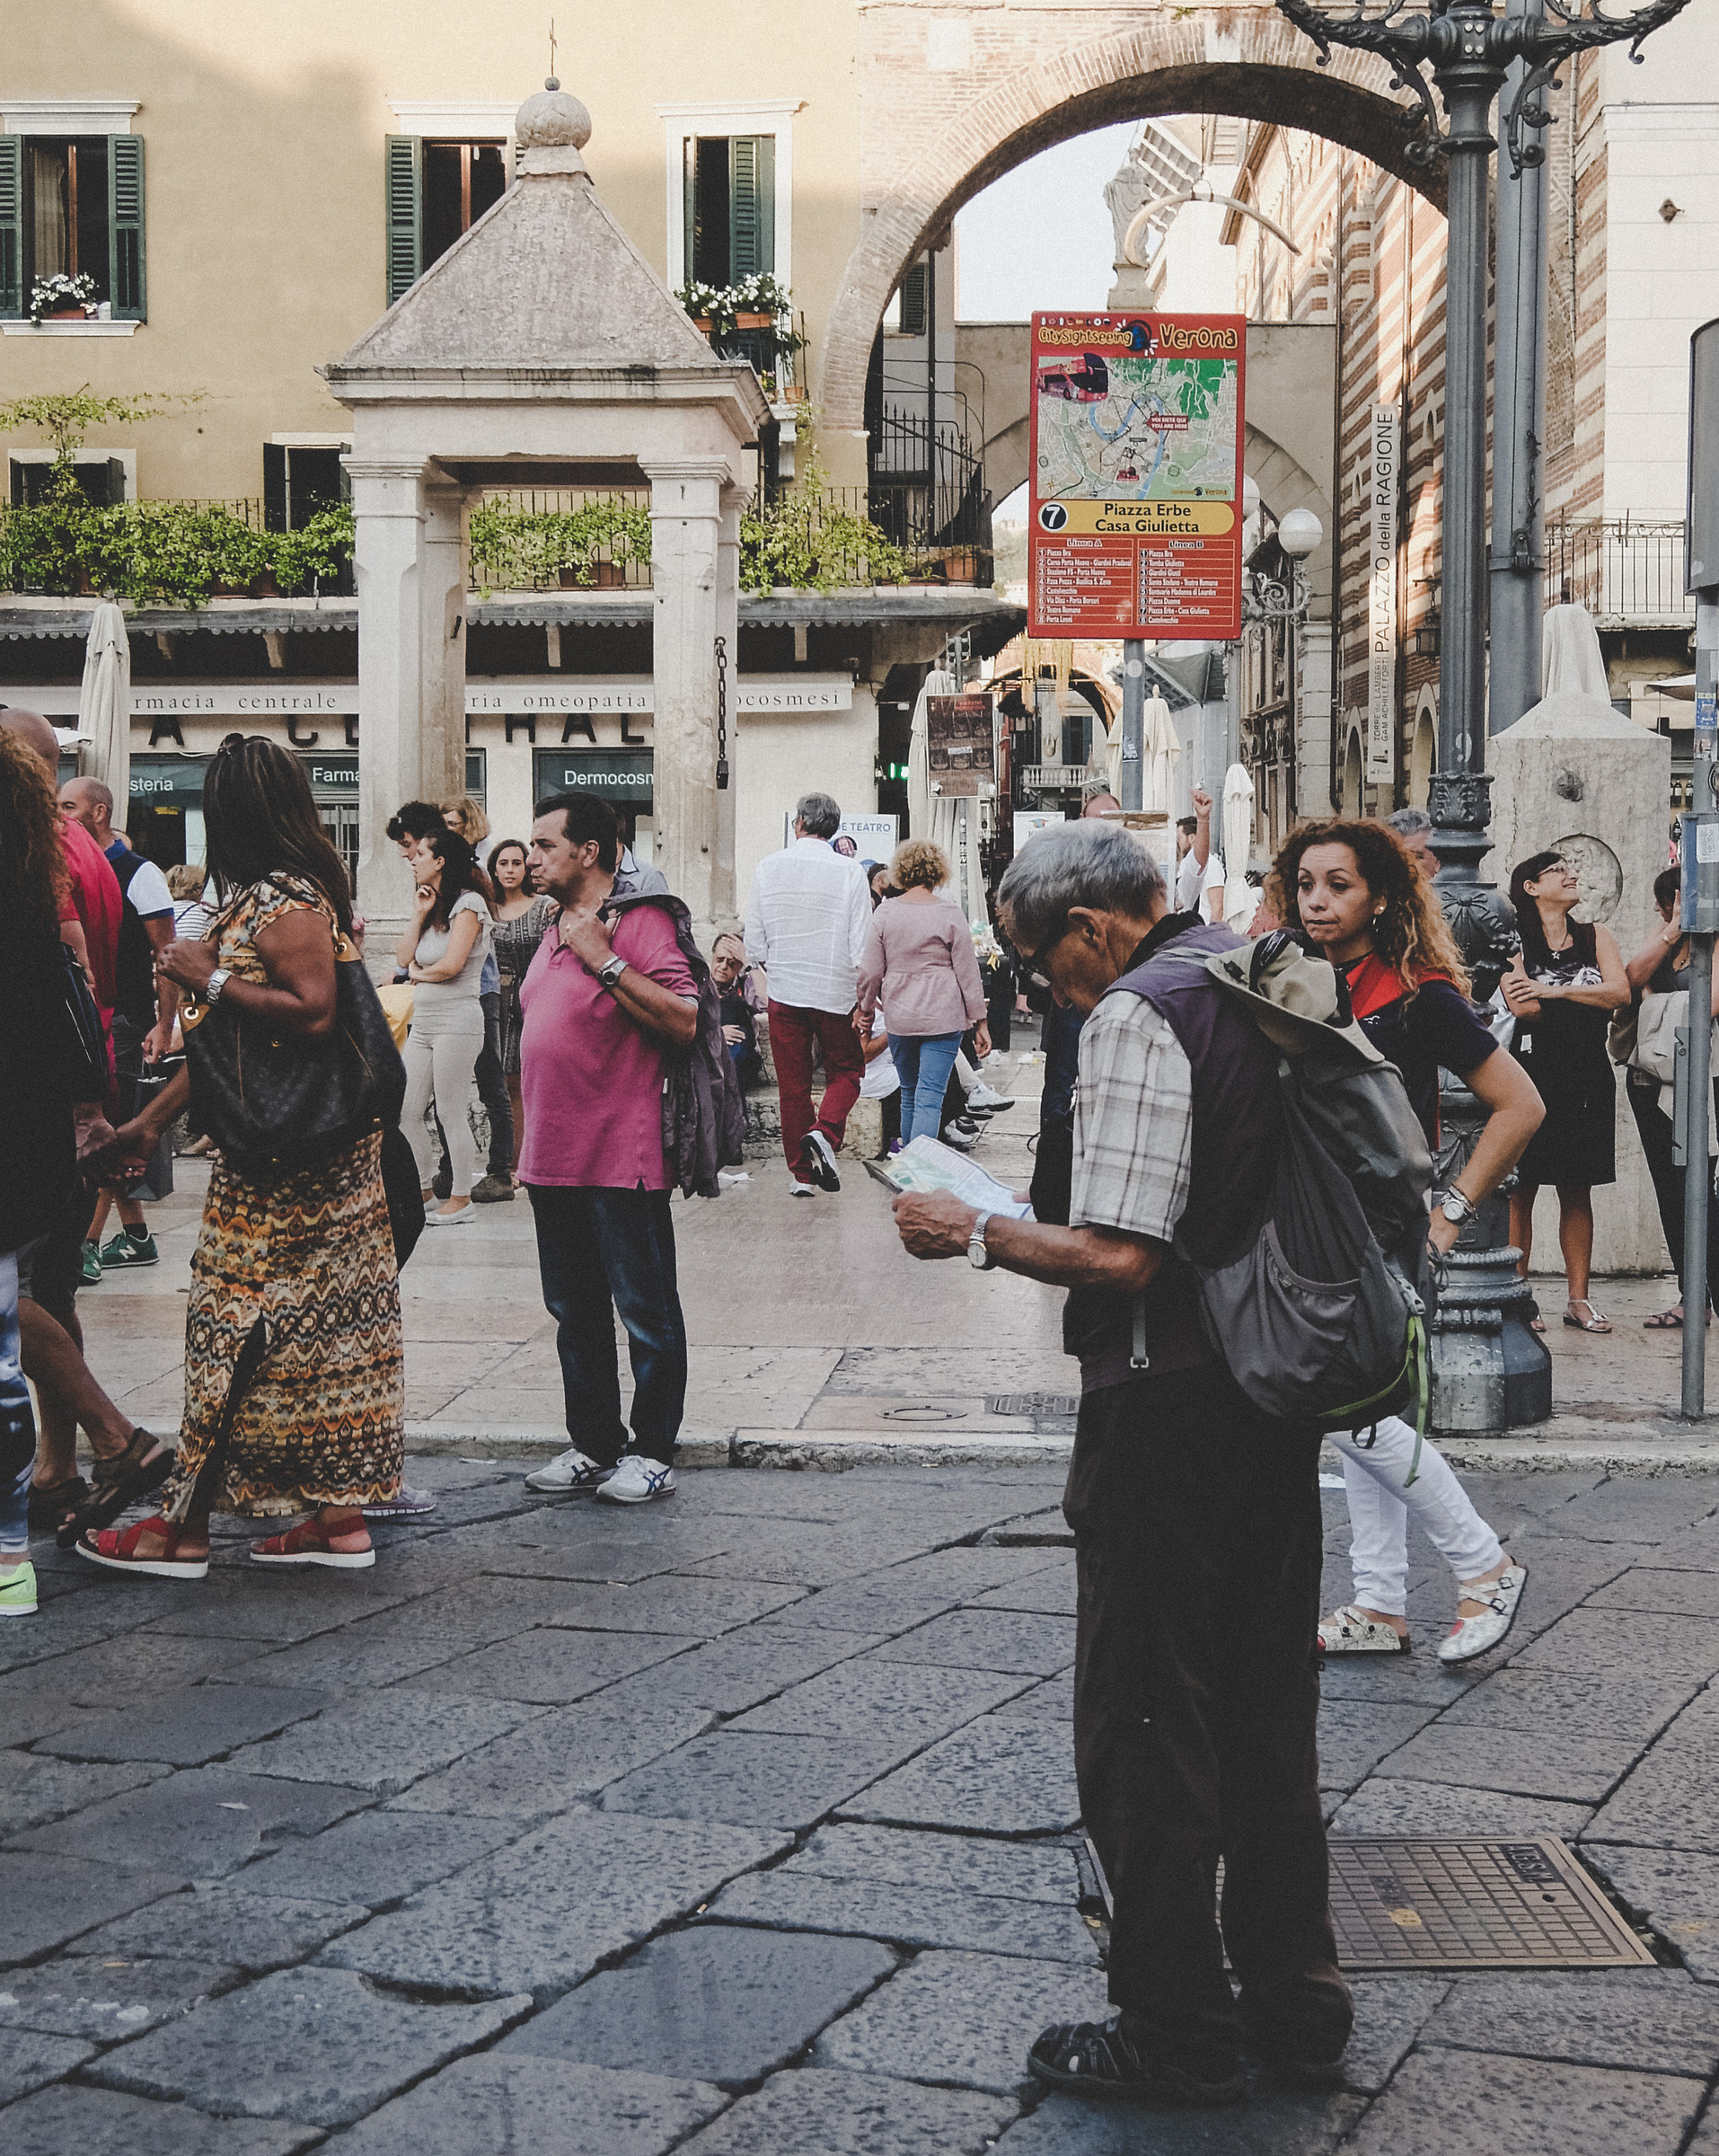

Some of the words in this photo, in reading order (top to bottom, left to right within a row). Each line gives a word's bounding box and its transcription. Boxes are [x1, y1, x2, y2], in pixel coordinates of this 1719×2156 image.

[1376, 413, 1393, 506] RAGIONE
[1046, 507, 1061, 527] 7
[1104, 503, 1151, 516] Piazza
[1157, 504, 1192, 517] Erbe
[1095, 519, 1131, 532] Casa
[1135, 519, 1200, 532] Giulietta
[1378, 513, 1391, 551] della
[1067, 539, 1094, 547] Linea
[1094, 539, 1103, 547] A
[1375, 556, 1389, 653] PALAZZO
[135, 694, 215, 708] rmacia
[238, 694, 337, 708] centrale
[472, 694, 501, 707] ria
[524, 693, 646, 710] omeopatia
[313, 767, 359, 782] Farma
[129, 777, 173, 791] steria
[851, 823, 891, 832] TEATRO
